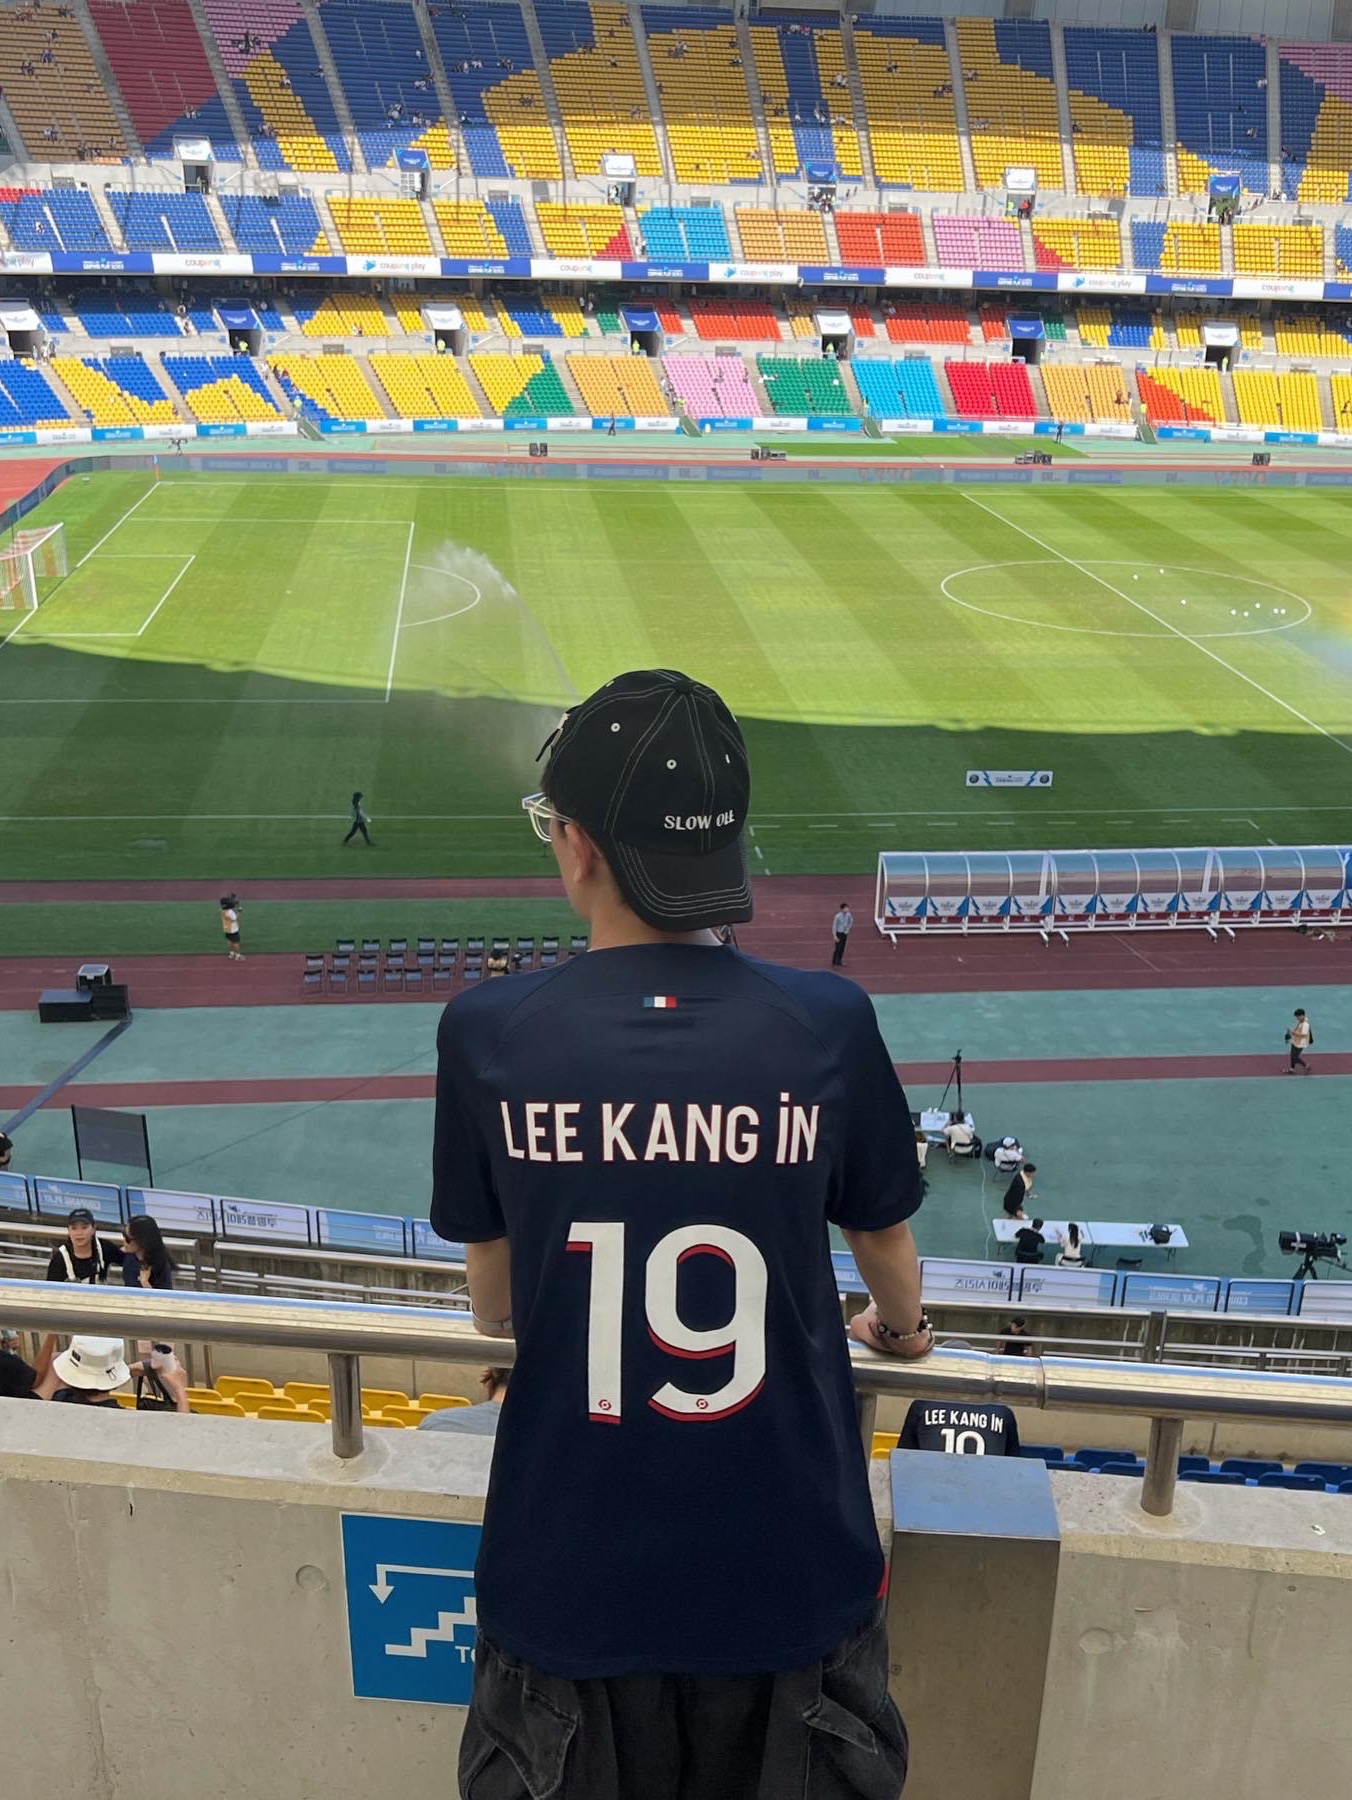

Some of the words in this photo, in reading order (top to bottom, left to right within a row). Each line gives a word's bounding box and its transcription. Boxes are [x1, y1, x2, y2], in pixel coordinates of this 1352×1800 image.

[664, 815, 712, 830] SLOW
[500, 1100, 583, 1162] LEE
[602, 1103, 759, 1163] KANG
[565, 1221, 768, 1424] 19
[925, 1409, 947, 1425] LEE
[950, 1410, 987, 1428] KANG
